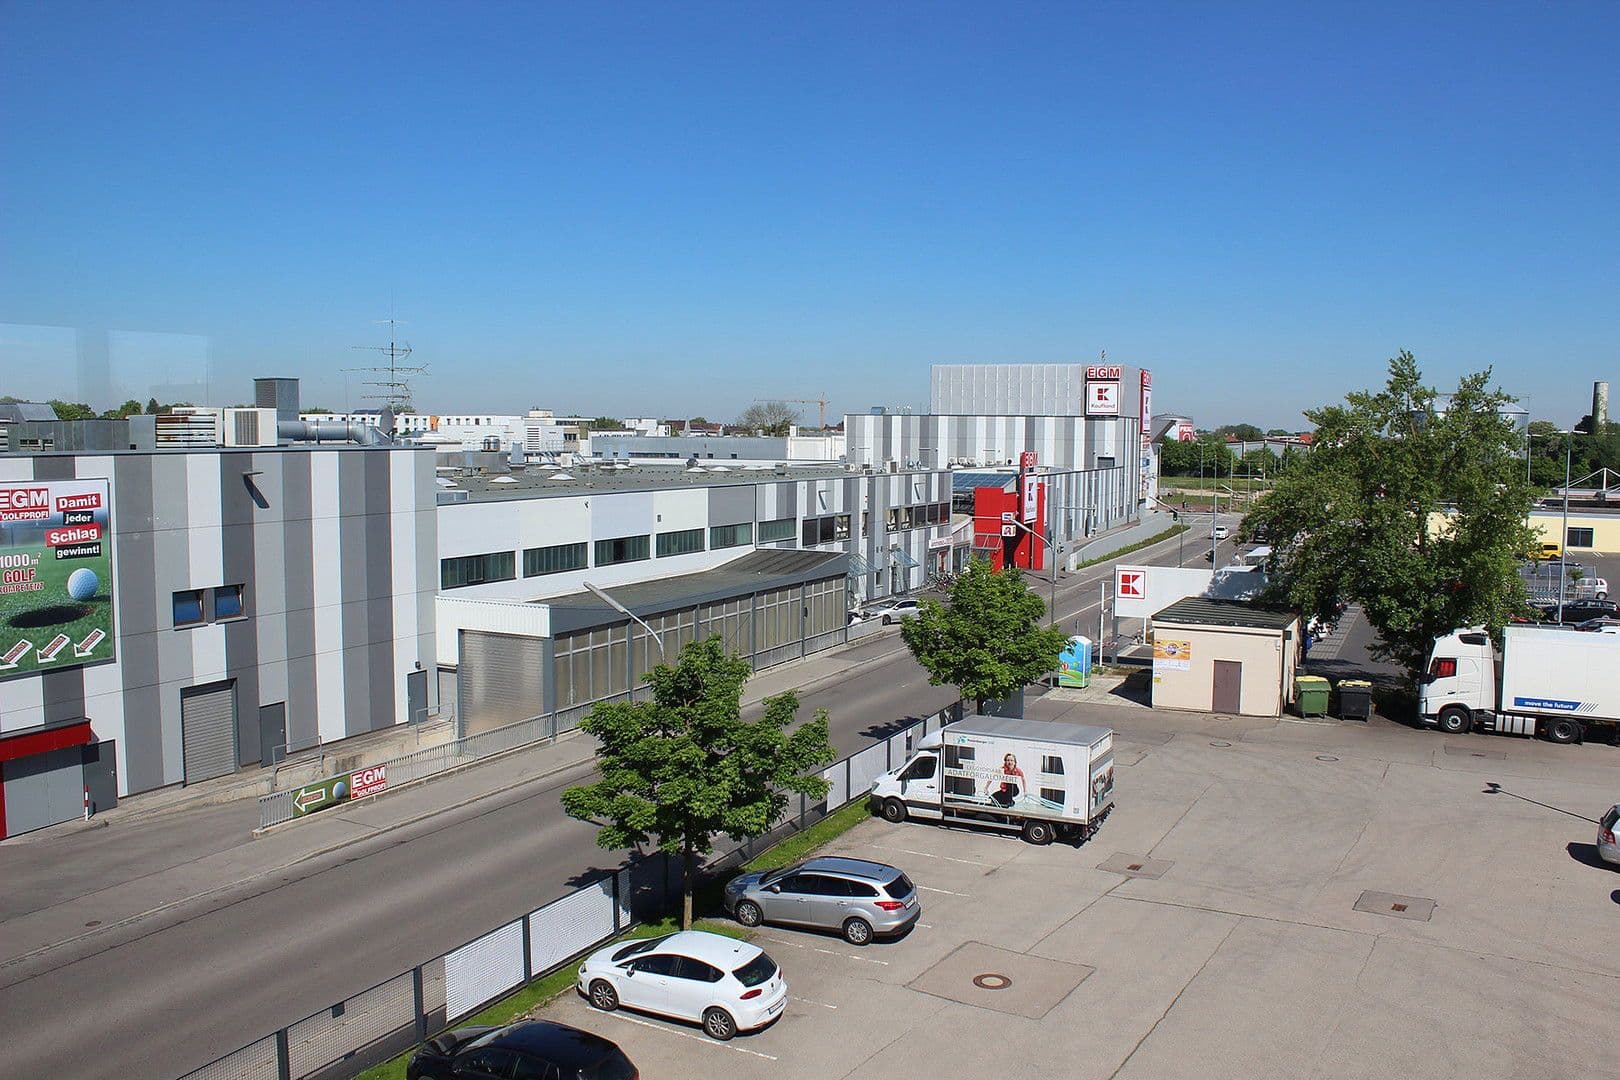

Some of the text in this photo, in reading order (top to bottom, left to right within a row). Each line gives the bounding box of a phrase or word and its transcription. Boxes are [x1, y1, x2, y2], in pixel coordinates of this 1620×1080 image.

[1087, 367, 1120, 378] EGM
[0, 490, 48, 508] EGM
[59, 495, 97, 508] Damit
[2, 512, 49, 520] GOLFPROFI
[65, 513, 92, 524] jeder
[50, 527, 98, 544] Schlag
[56, 545, 100, 558] gewinnt!
[0, 554, 30, 568] 1000
[4, 568, 36, 583] GOLF
[1121, 574, 1141, 595] K
[1554, 702, 1574, 710] future
[352, 767, 386, 788] EGM
